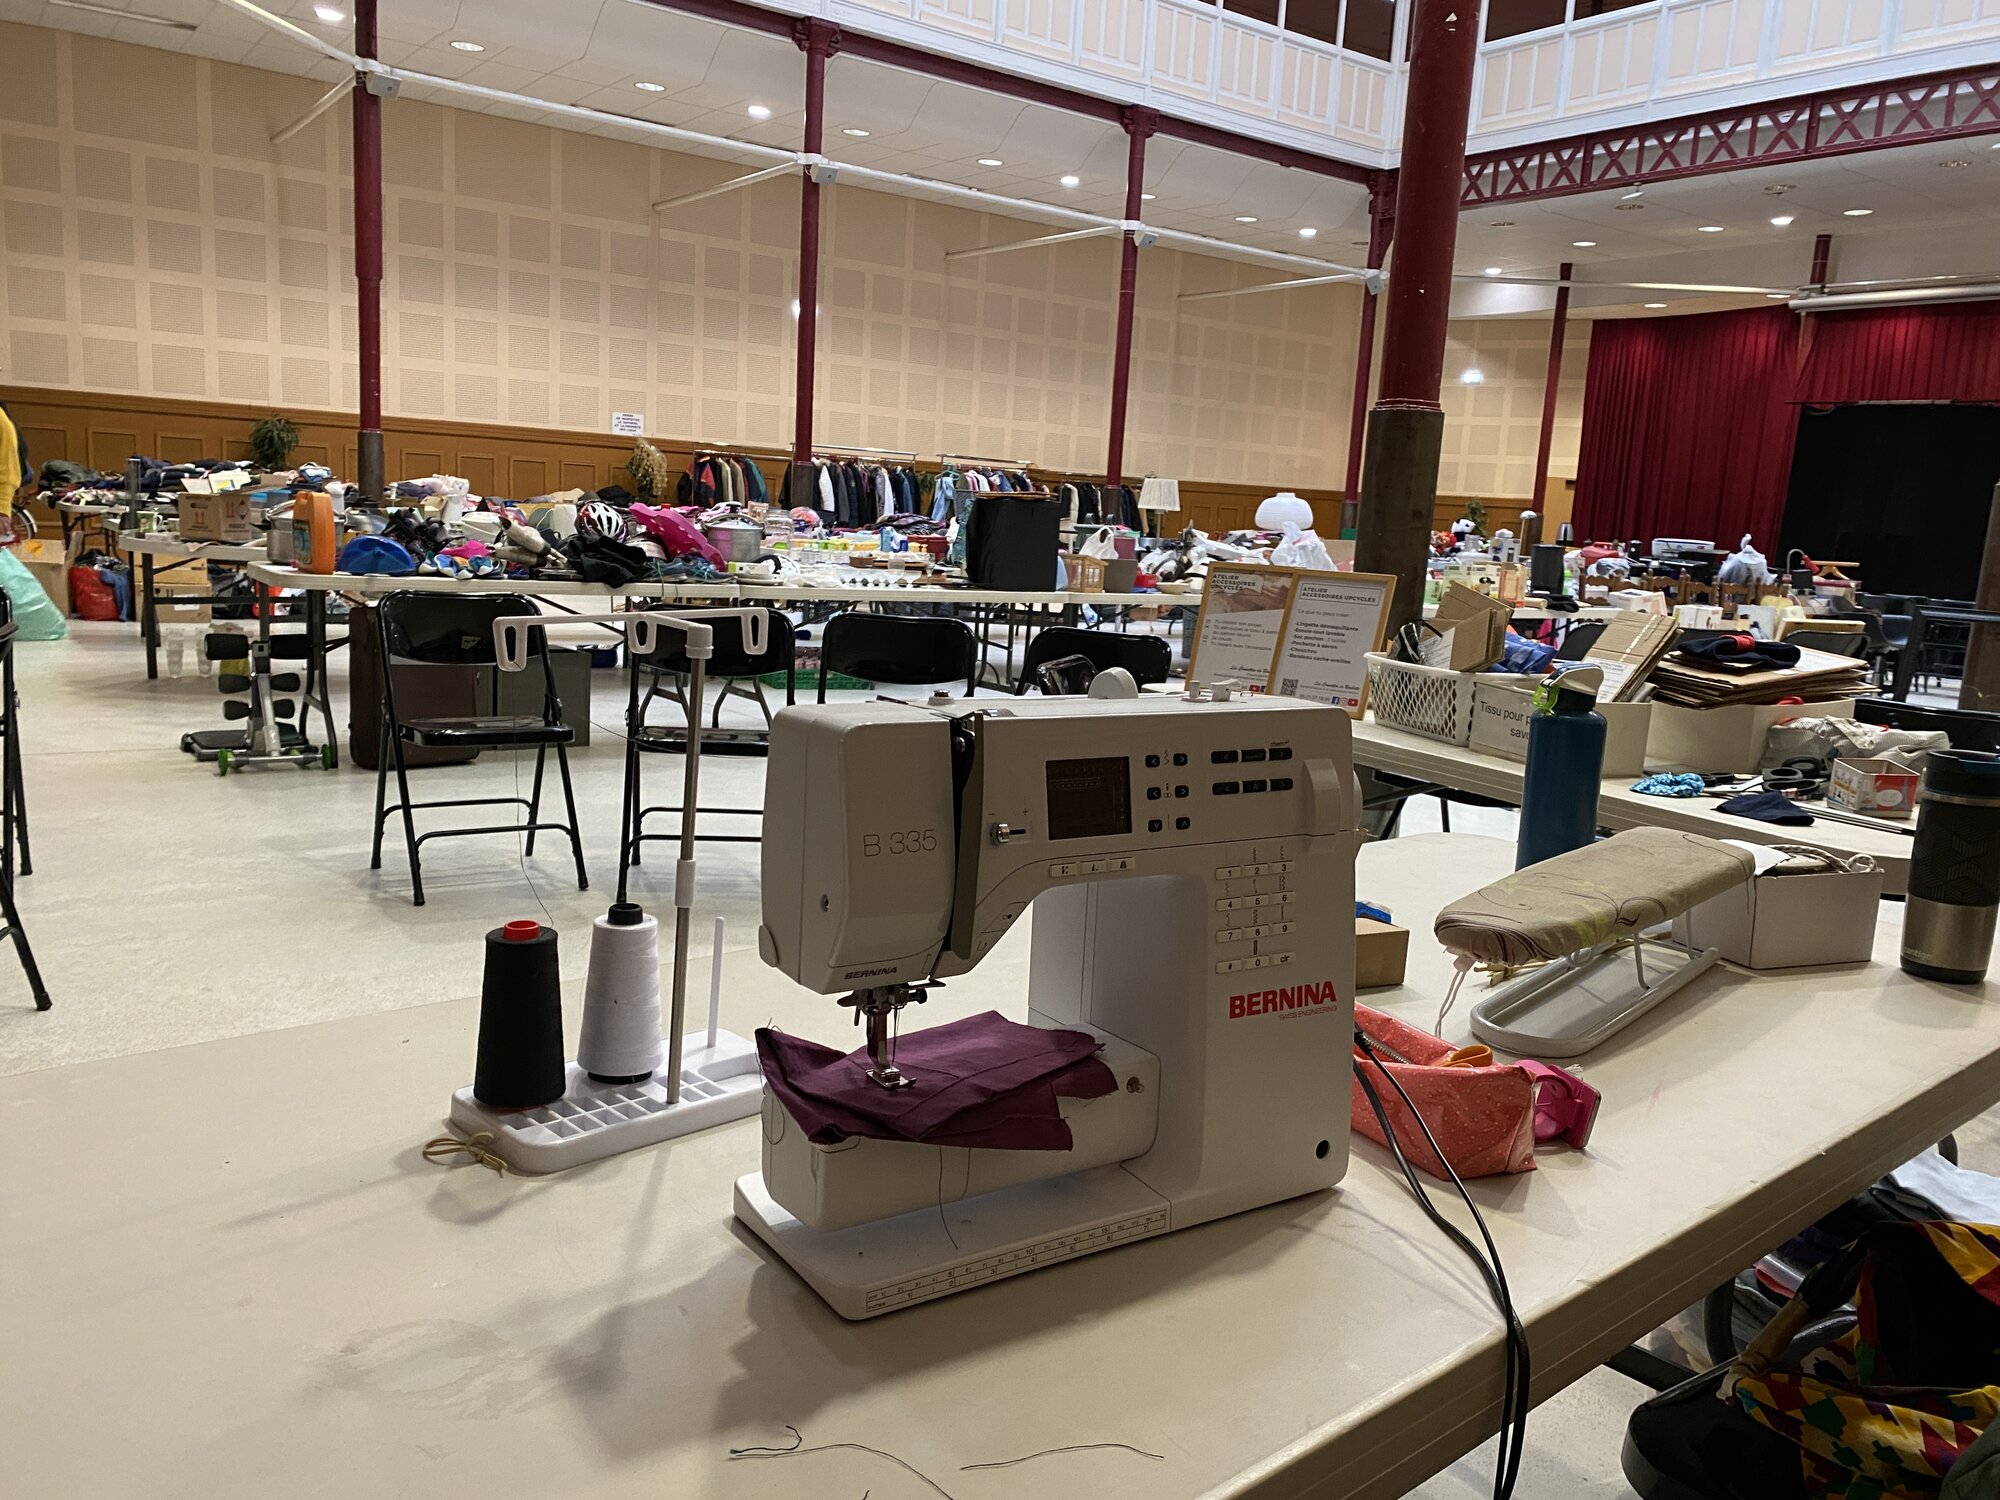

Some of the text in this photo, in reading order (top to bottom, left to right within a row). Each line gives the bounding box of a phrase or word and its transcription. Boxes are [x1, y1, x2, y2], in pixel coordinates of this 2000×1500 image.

[1302, 592, 1343, 600] ACCESSOIRES
[1480, 700, 1531, 726] Tissu pour p
[863, 829, 937, 857] B 335
[844, 966, 898, 980] BERNINA
[1229, 980, 1337, 1019] BERNINA
[1297, 1004, 1337, 1018] ENGINEERING
